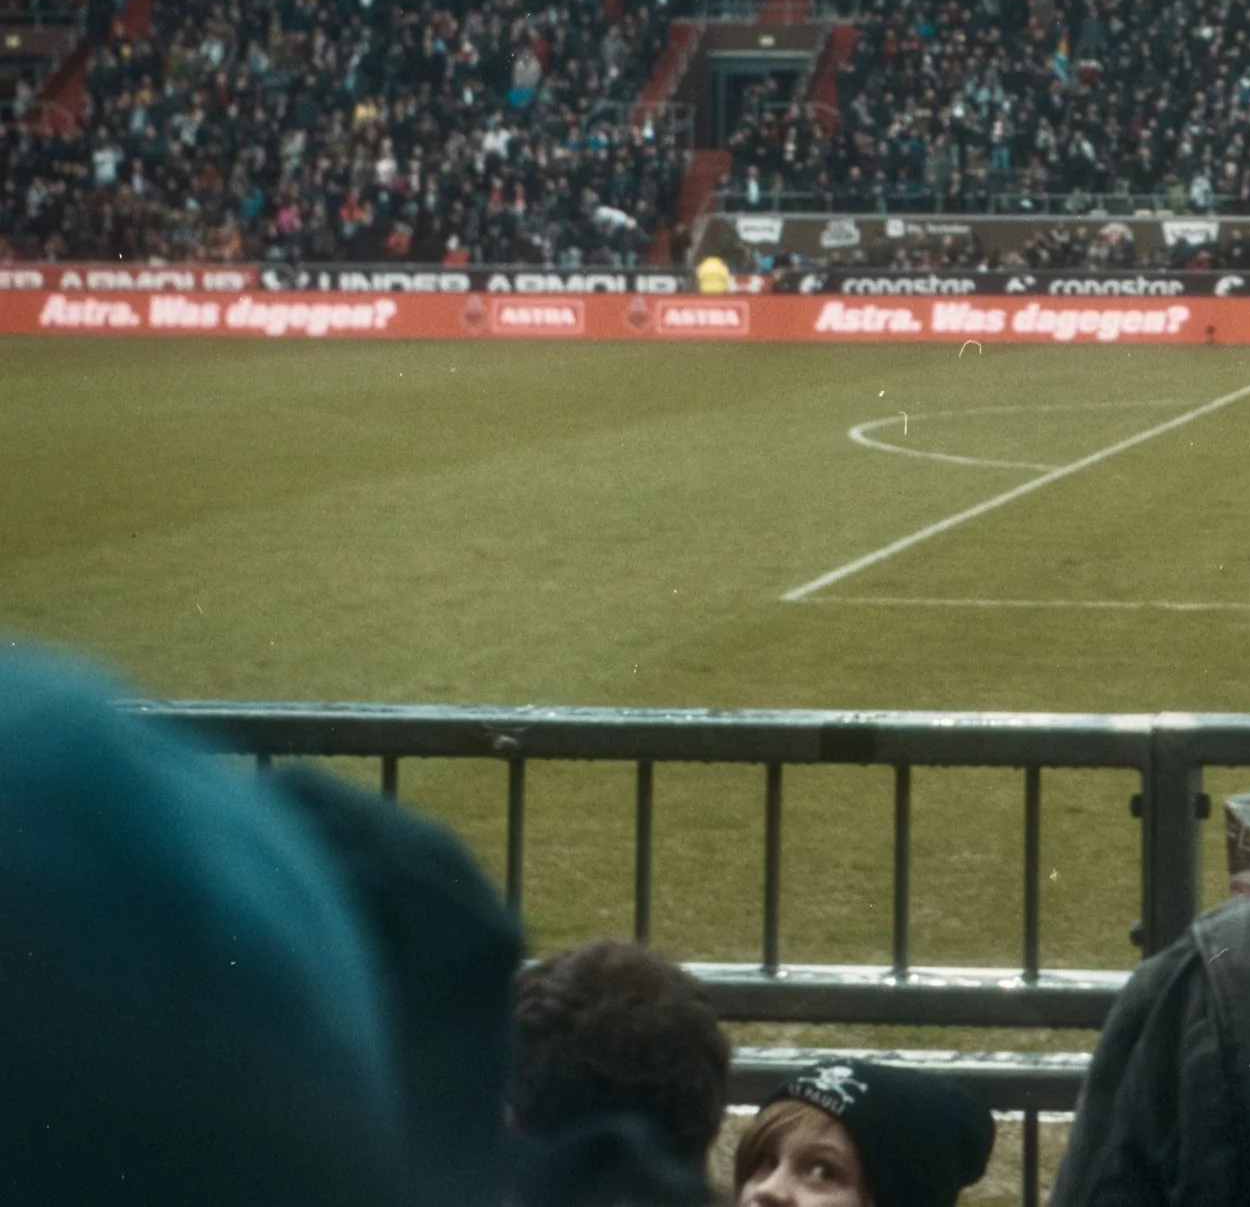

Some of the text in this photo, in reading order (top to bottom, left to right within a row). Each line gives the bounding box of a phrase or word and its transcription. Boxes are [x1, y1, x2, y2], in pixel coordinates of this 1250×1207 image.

[40, 295, 396, 335] Astra. Was dagegen?
[500, 307, 575, 325] ASTRA
[663, 309, 739, 326] ASTRA
[816, 301, 1189, 340] Astra. Was dagegen?
